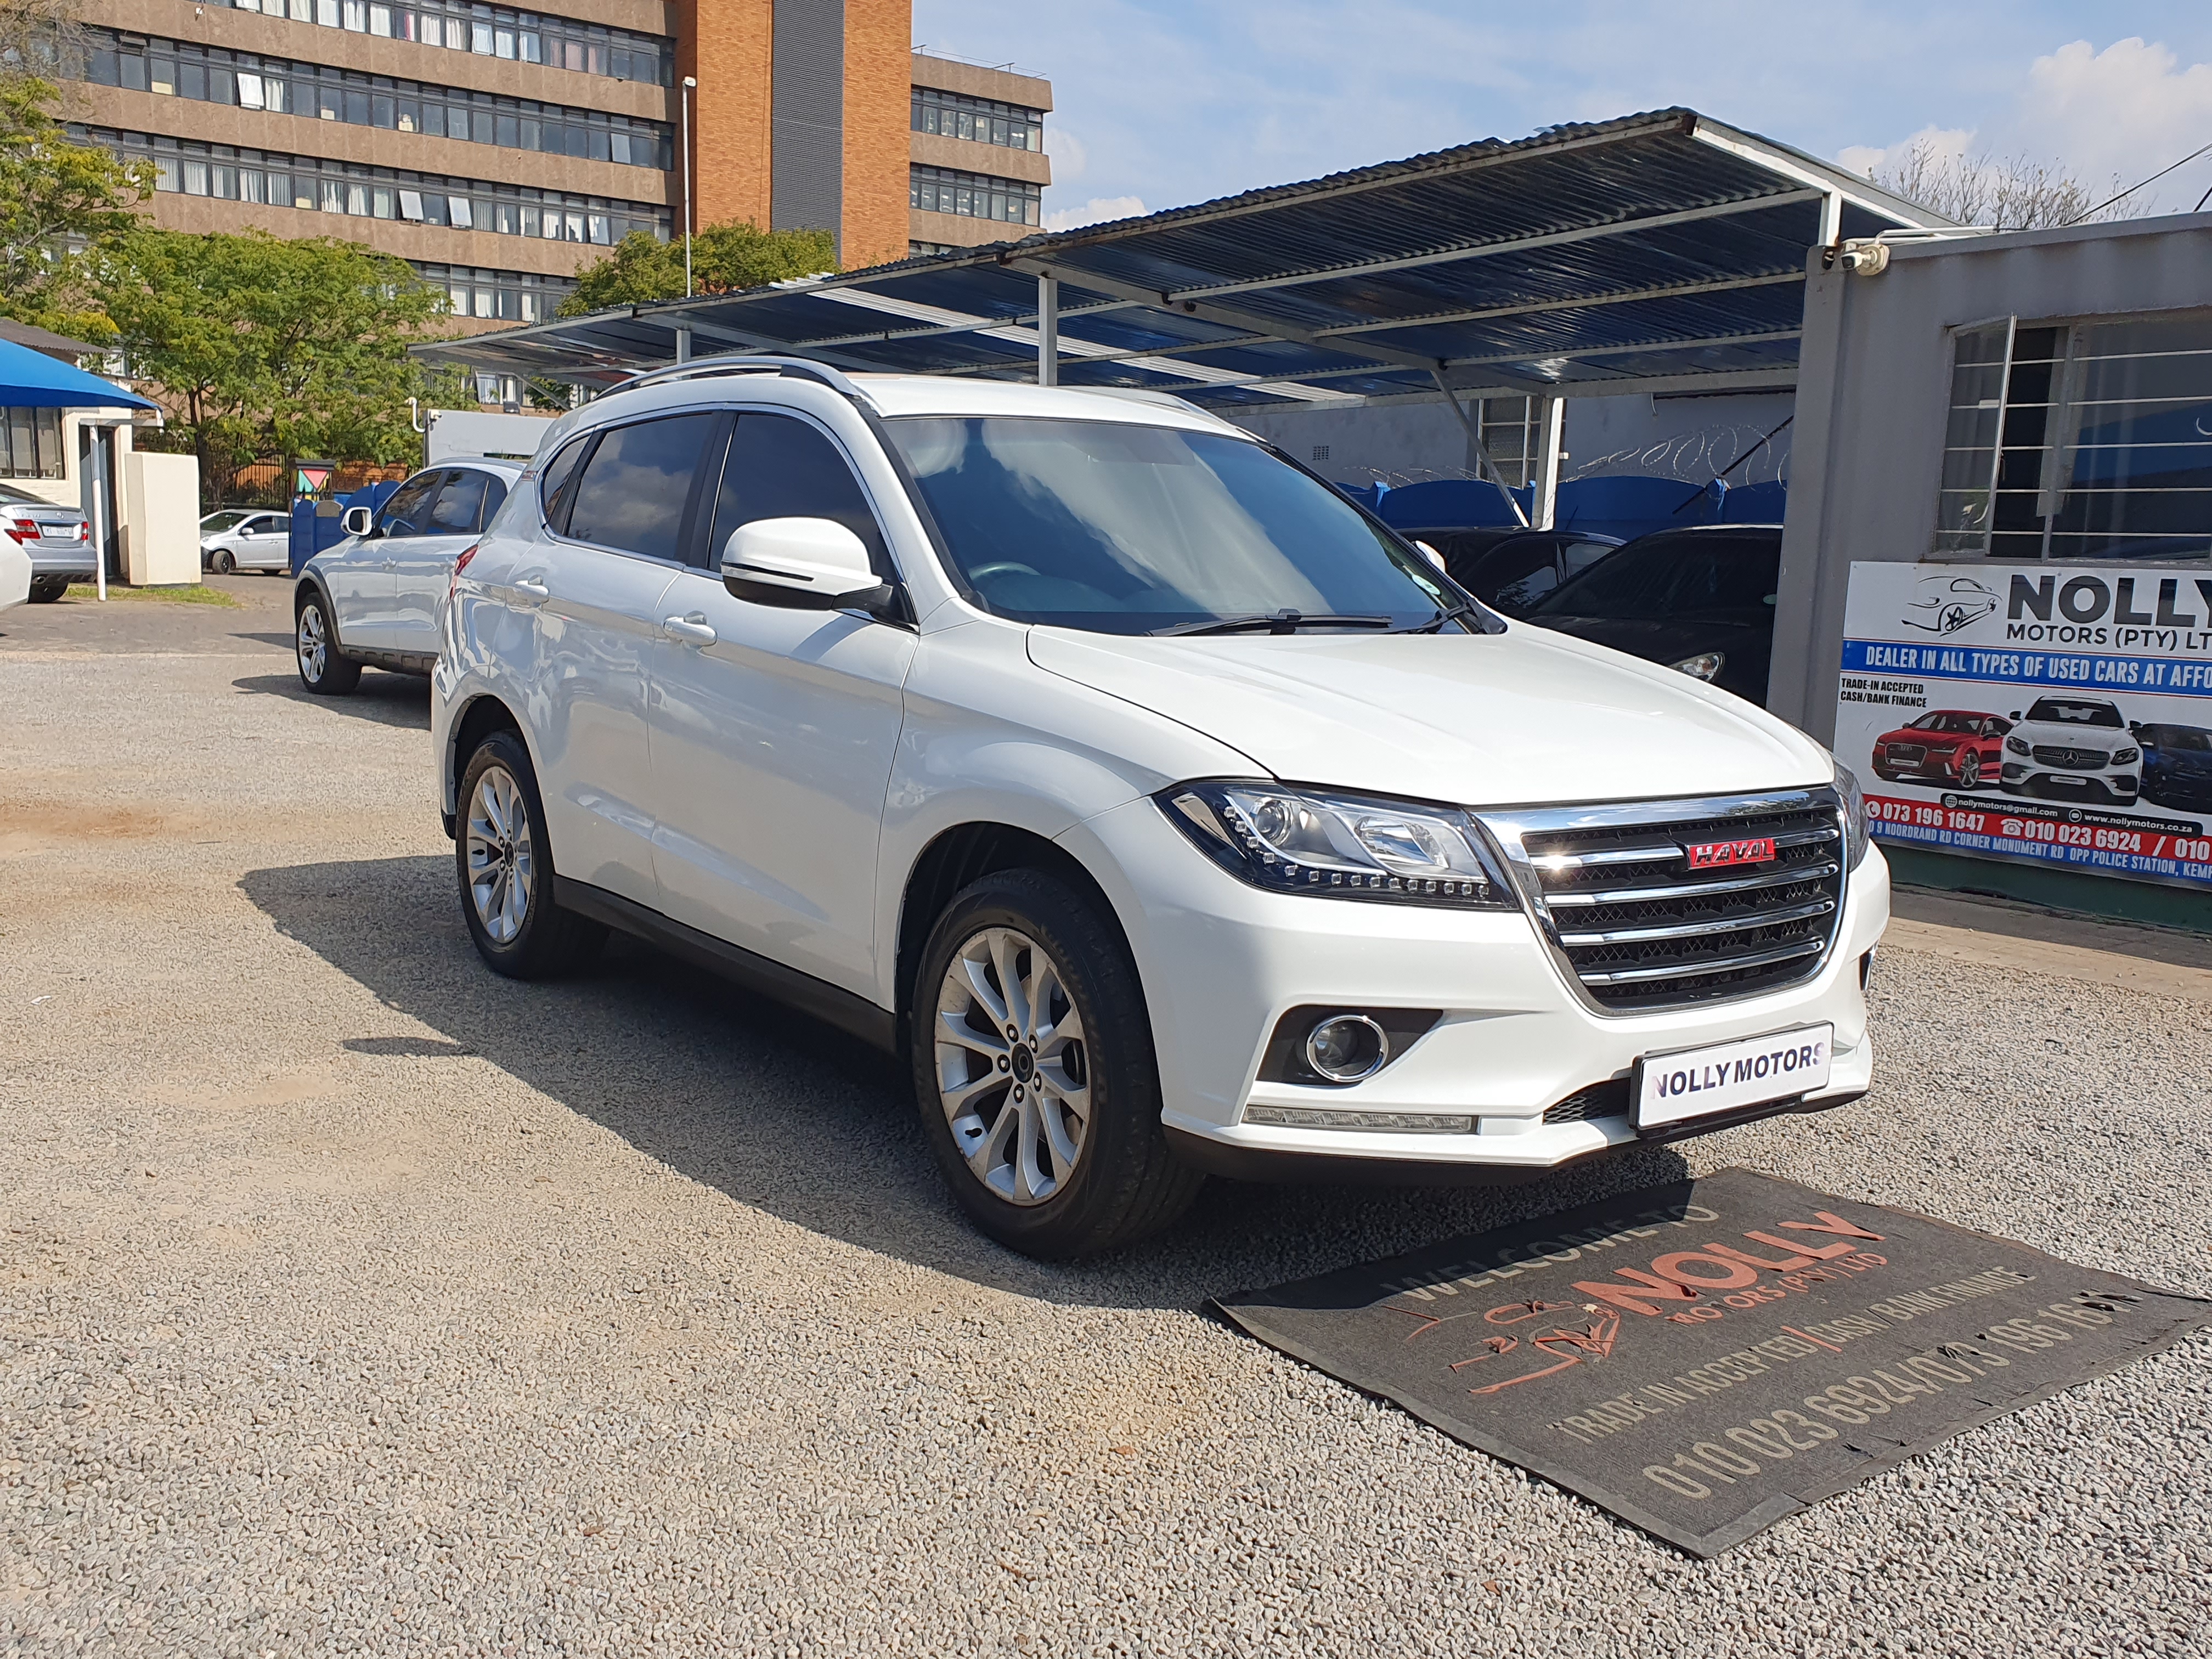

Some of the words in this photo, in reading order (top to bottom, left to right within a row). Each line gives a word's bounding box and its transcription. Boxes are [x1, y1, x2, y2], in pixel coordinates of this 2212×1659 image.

[2006, 623, 2107, 645] MOTORS
[2115, 627, 2177, 651] (PTY)
[1841, 678, 1879, 691] TRADE-IN
[1881, 682, 1924, 695] ACCEPTED
[1866, 646, 1917, 669] DEALER
[1921, 649, 1937, 670] IN
[1939, 650, 1966, 672] ALL
[1972, 652, 2019, 676] TYPES
[2024, 656, 2044, 677] OF
[2048, 658, 2090, 681] USED
[2095, 661, 2138, 684] CARS
[2143, 663, 2166, 685] AT
[1840, 691, 1890, 705] CASH/BANK
[1892, 695, 1927, 708] FINANCE
[1883, 802, 1911, 822] 073
[1915, 807, 1944, 826] 196
[1947, 811, 1985, 832] 1647
[2025, 820, 2056, 842] 010
[2058, 825, 2092, 846] 023
[2095, 829, 2141, 853] 6924
[2152, 836, 2167, 857] /
[2174, 838, 2210, 861] 010
[1958, 799, 2058, 817] nollymotors@gmail.com
[2085, 812, 2193, 833] www.nollymotors.co.za
[1694, 840, 1775, 866] HAVAL
[1876, 821, 1882, 833] 9
[1884, 822, 1937, 842] NOORDRAND
[1939, 830, 1952, 844] RD
[1954, 832, 1991, 849] CORNER
[1993, 837, 2049, 857] MONUMENT
[2051, 845, 2064, 859] RD
[2069, 848, 2090, 862] OPP
[2092, 850, 2128, 868] POLICE
[2131, 855, 2179, 877] STATION,
[1651, 1062, 1731, 1099] NOLLY
[1734, 1042, 1825, 1084] MOTORS
[1379, 1219, 1659, 1301] WELCOME
[1636, 1205, 1719, 1228] TO
[1571, 1211, 1886, 1317] NOLLY
[1545, 1391, 1666, 1445] TRADE
[1639, 1382, 1697, 1407] IN
[1674, 1334, 1819, 1396] ACCEPTED
[1927, 1266, 2037, 1302] FINANCE
[1641, 1441, 1761, 1499] 010
[1725, 1408, 1840, 1459] 023
[1977, 1317, 2073, 1354] 196
